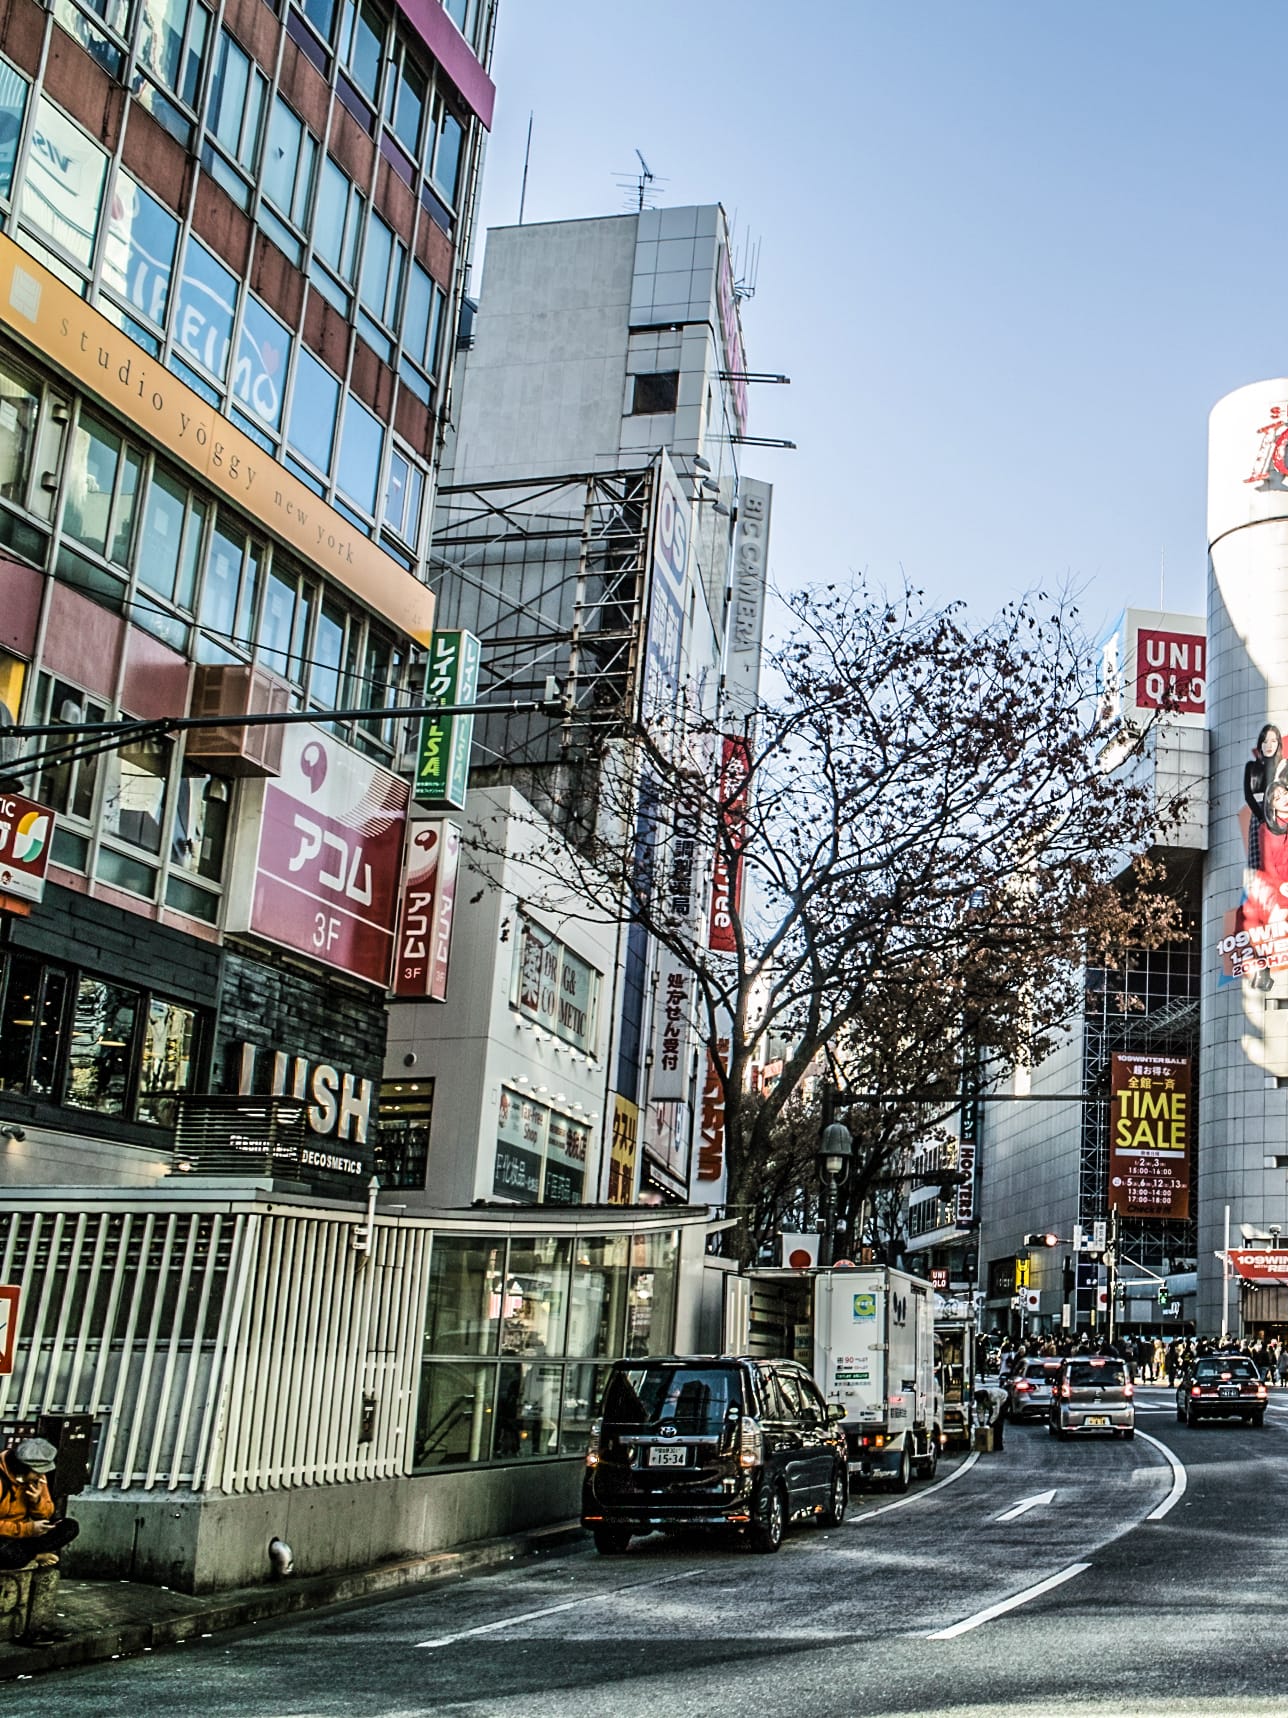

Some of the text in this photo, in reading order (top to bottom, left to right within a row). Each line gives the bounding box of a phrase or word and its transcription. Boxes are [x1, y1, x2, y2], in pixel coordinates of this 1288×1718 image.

[60, 314, 166, 414] studio
[273, 487, 310, 527] new
[316, 524, 354, 566] york
[1146, 639, 1204, 668] UNI
[288, 812, 372, 907] アコム
[312, 912, 342, 951] 3F
[404, 892, 431, 959] アコム
[404, 967, 422, 979] 3F
[541, 984, 588, 1038] COMETIC
[661, 973, 688, 1071] 処方せん受付
[1116, 1089, 1187, 1121] TIME
[1115, 1119, 1186, 1149] SALE
[932, 1270, 947, 1279] UNI
[932, 1279, 947, 1288] QLO
